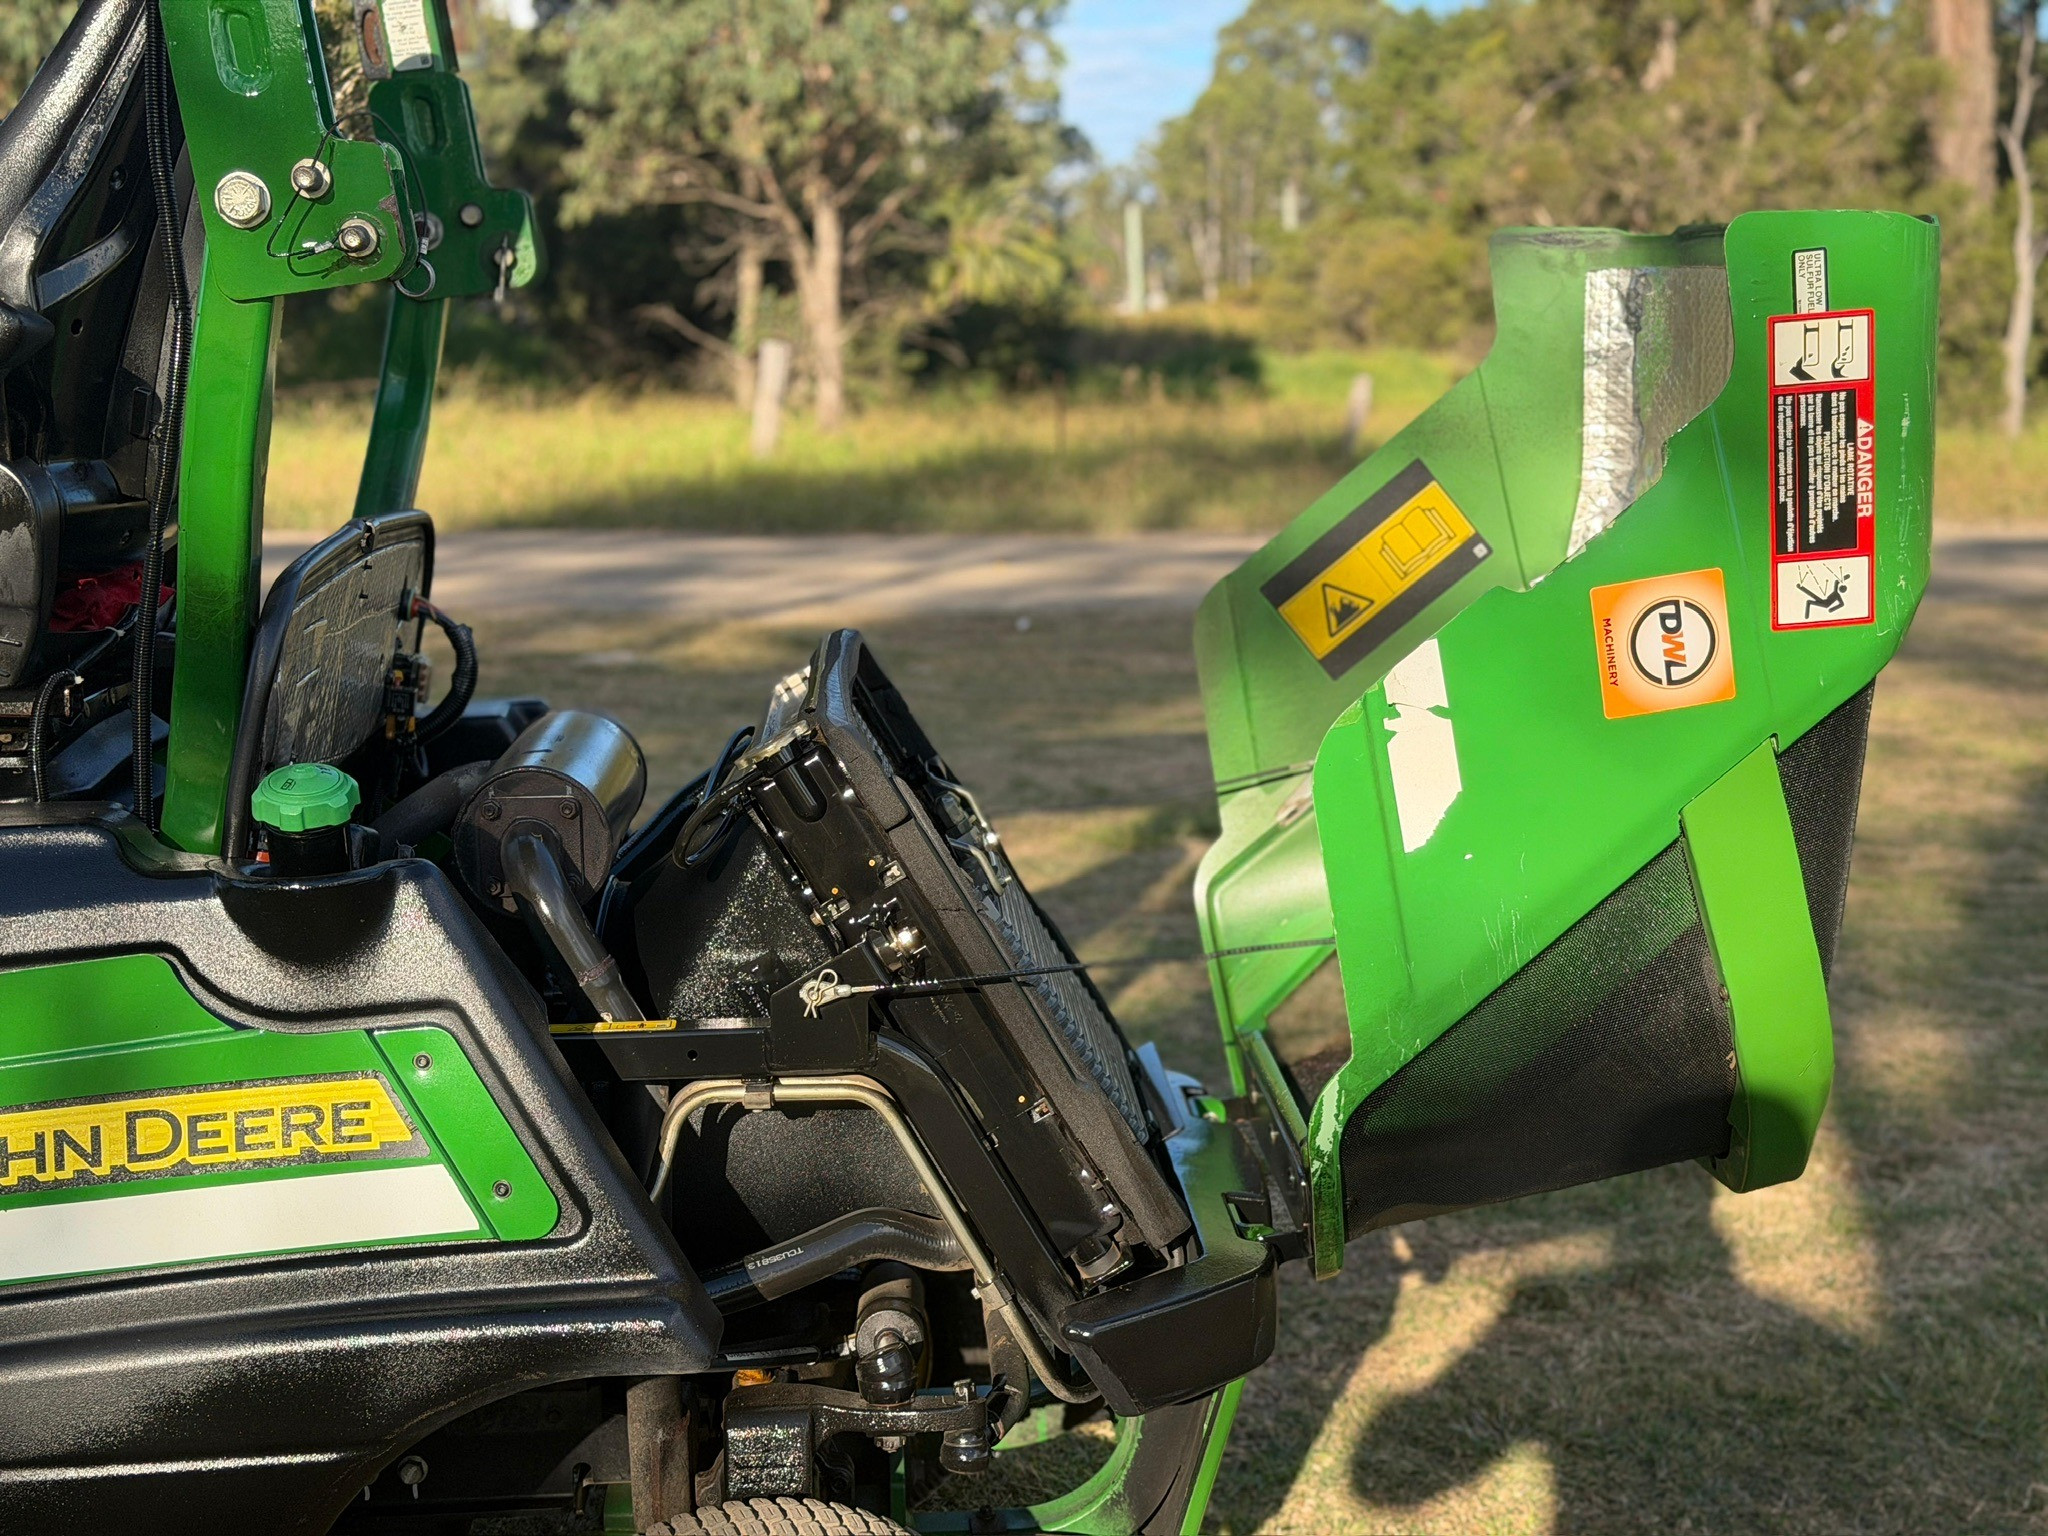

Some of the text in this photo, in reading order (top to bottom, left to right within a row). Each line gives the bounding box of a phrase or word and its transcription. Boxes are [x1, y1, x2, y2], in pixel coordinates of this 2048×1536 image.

[1806, 254, 1815, 313] SULFUR FUEL
[1814, 253, 1823, 305] ULTRA LOW
[1823, 431, 1831, 473] PROJECTION
[1857, 437, 1872, 518] DANGER
[1602, 617, 1619, 687] MACHINERY
[125, 1101, 371, 1163] DEERE
